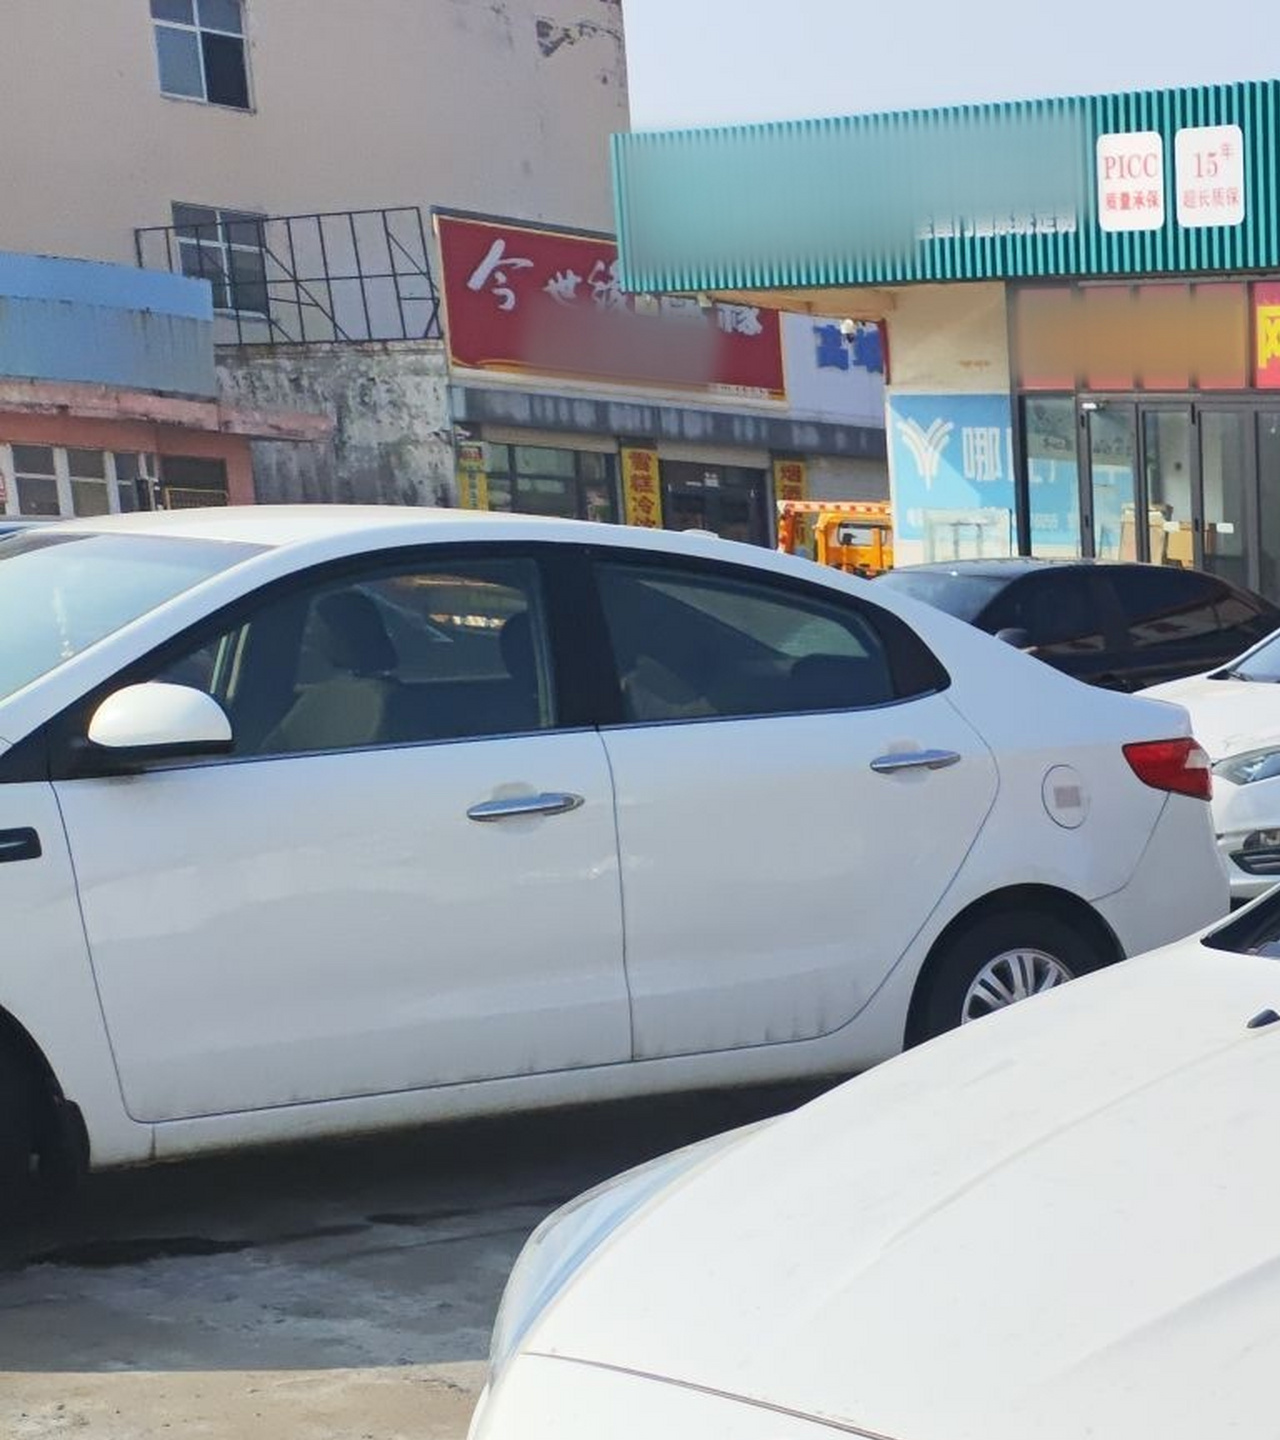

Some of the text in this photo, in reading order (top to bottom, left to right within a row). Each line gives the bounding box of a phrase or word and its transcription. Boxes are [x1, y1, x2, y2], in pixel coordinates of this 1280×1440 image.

[1104, 153, 1158, 179] PICC
[1183, 187, 1239, 209] 超长质保
